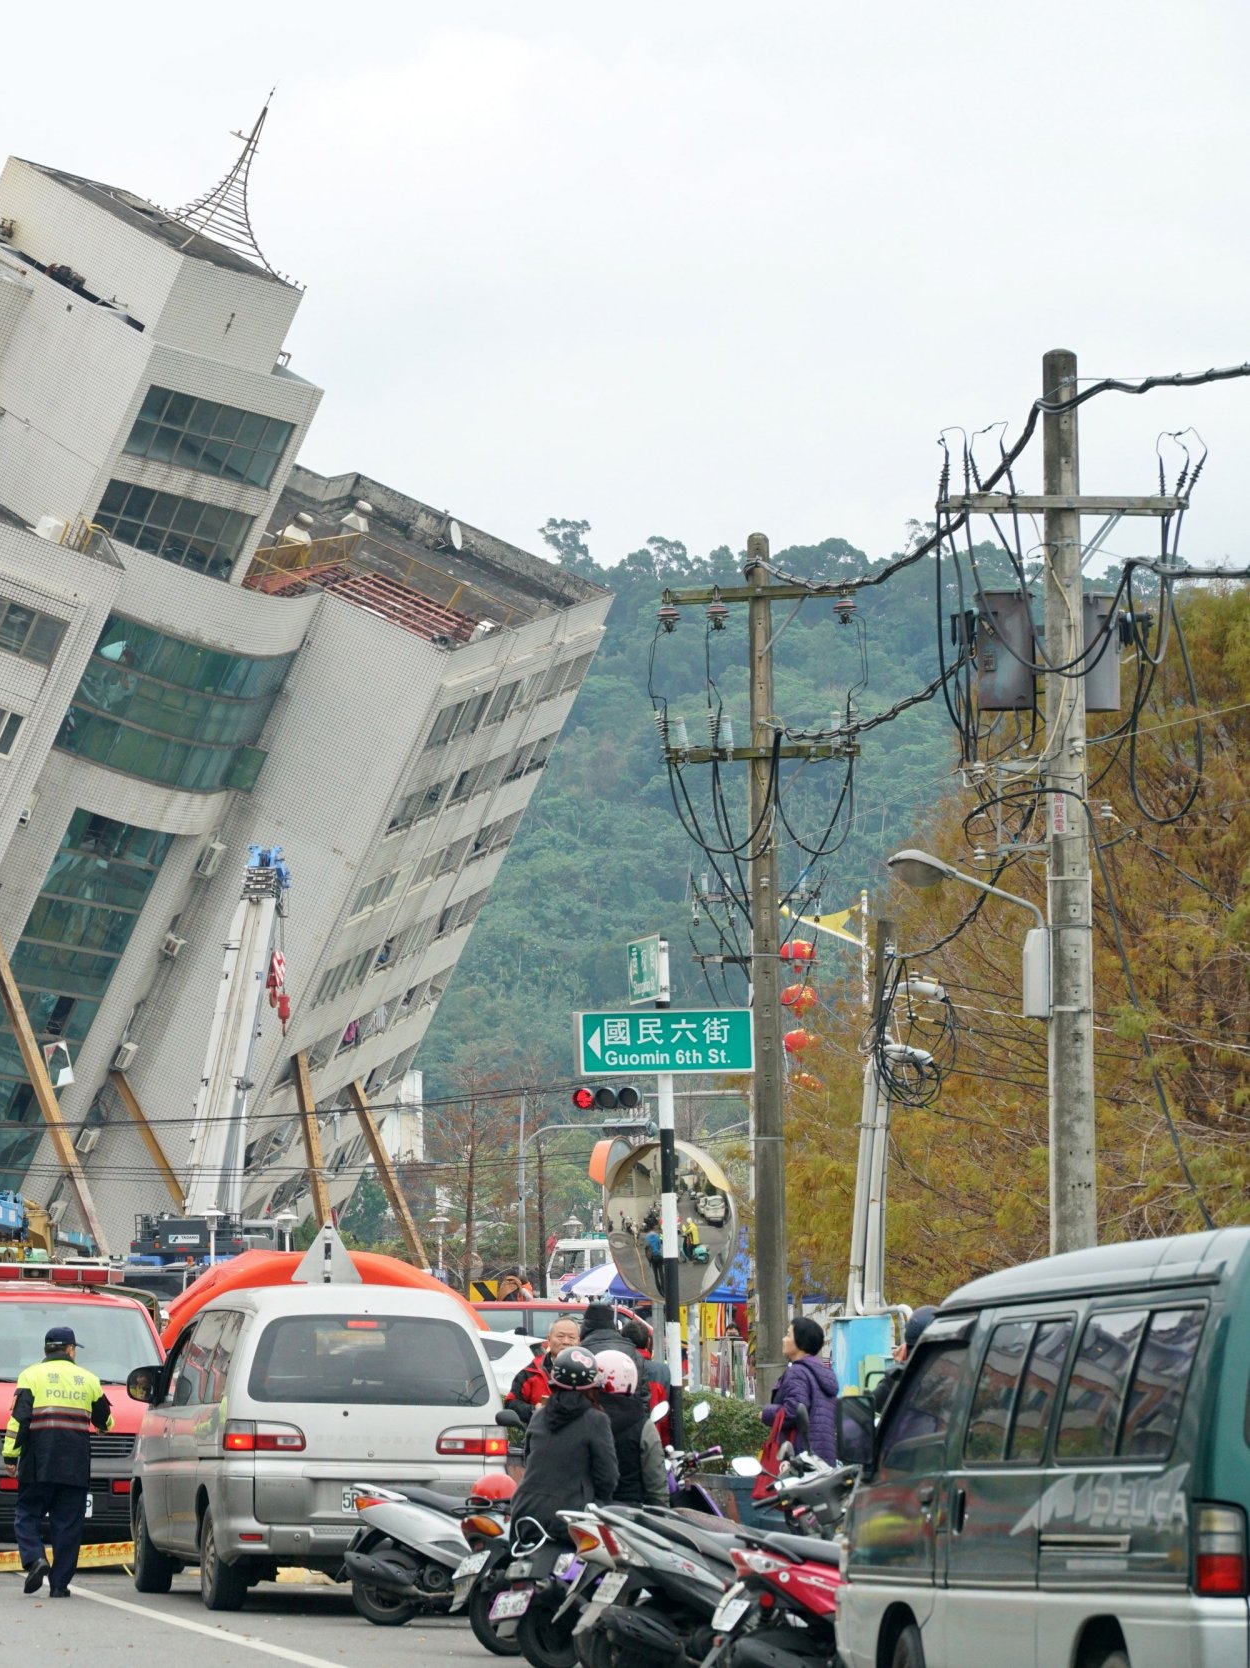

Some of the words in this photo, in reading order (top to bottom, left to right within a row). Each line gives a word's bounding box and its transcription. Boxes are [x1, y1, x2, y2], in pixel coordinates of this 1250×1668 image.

[604, 1017, 730, 1046] 國民六街
[605, 1050, 670, 1066] Guomin
[675, 1049, 703, 1064] 6th
[708, 1048, 731, 1064] St.
[46, 1389, 87, 1401] POLICE
